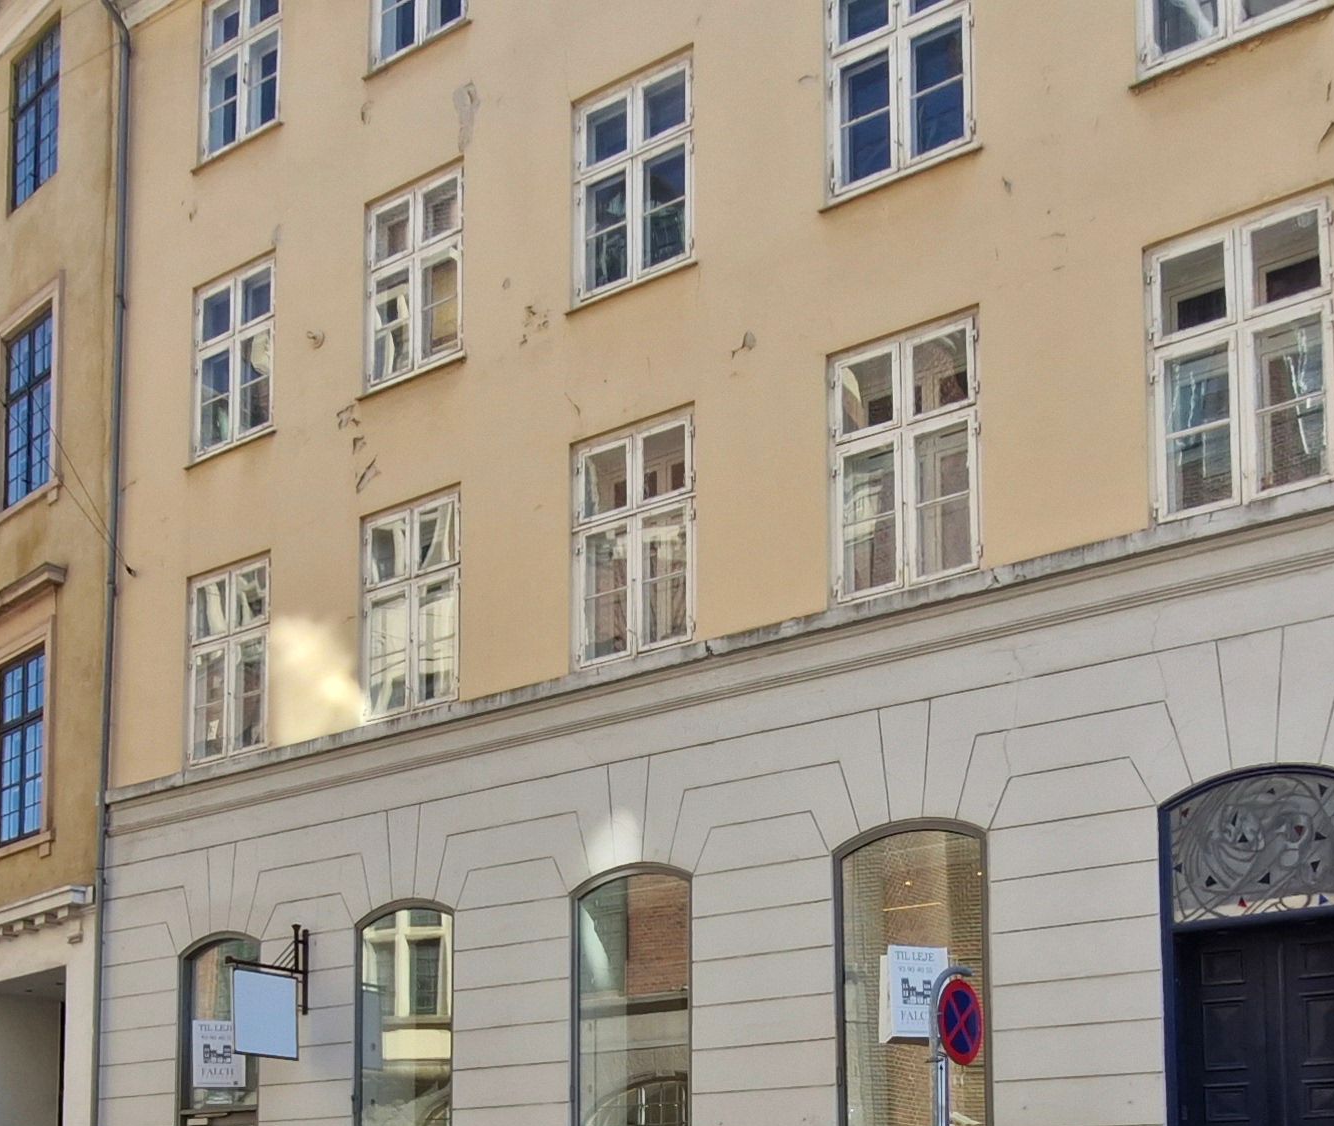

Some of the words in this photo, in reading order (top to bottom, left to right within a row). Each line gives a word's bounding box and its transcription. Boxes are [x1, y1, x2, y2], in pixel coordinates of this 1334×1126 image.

[894, 950, 910, 960] TIL
[912, 951, 935, 962] LEJE
[900, 1010, 929, 1021] FALC
